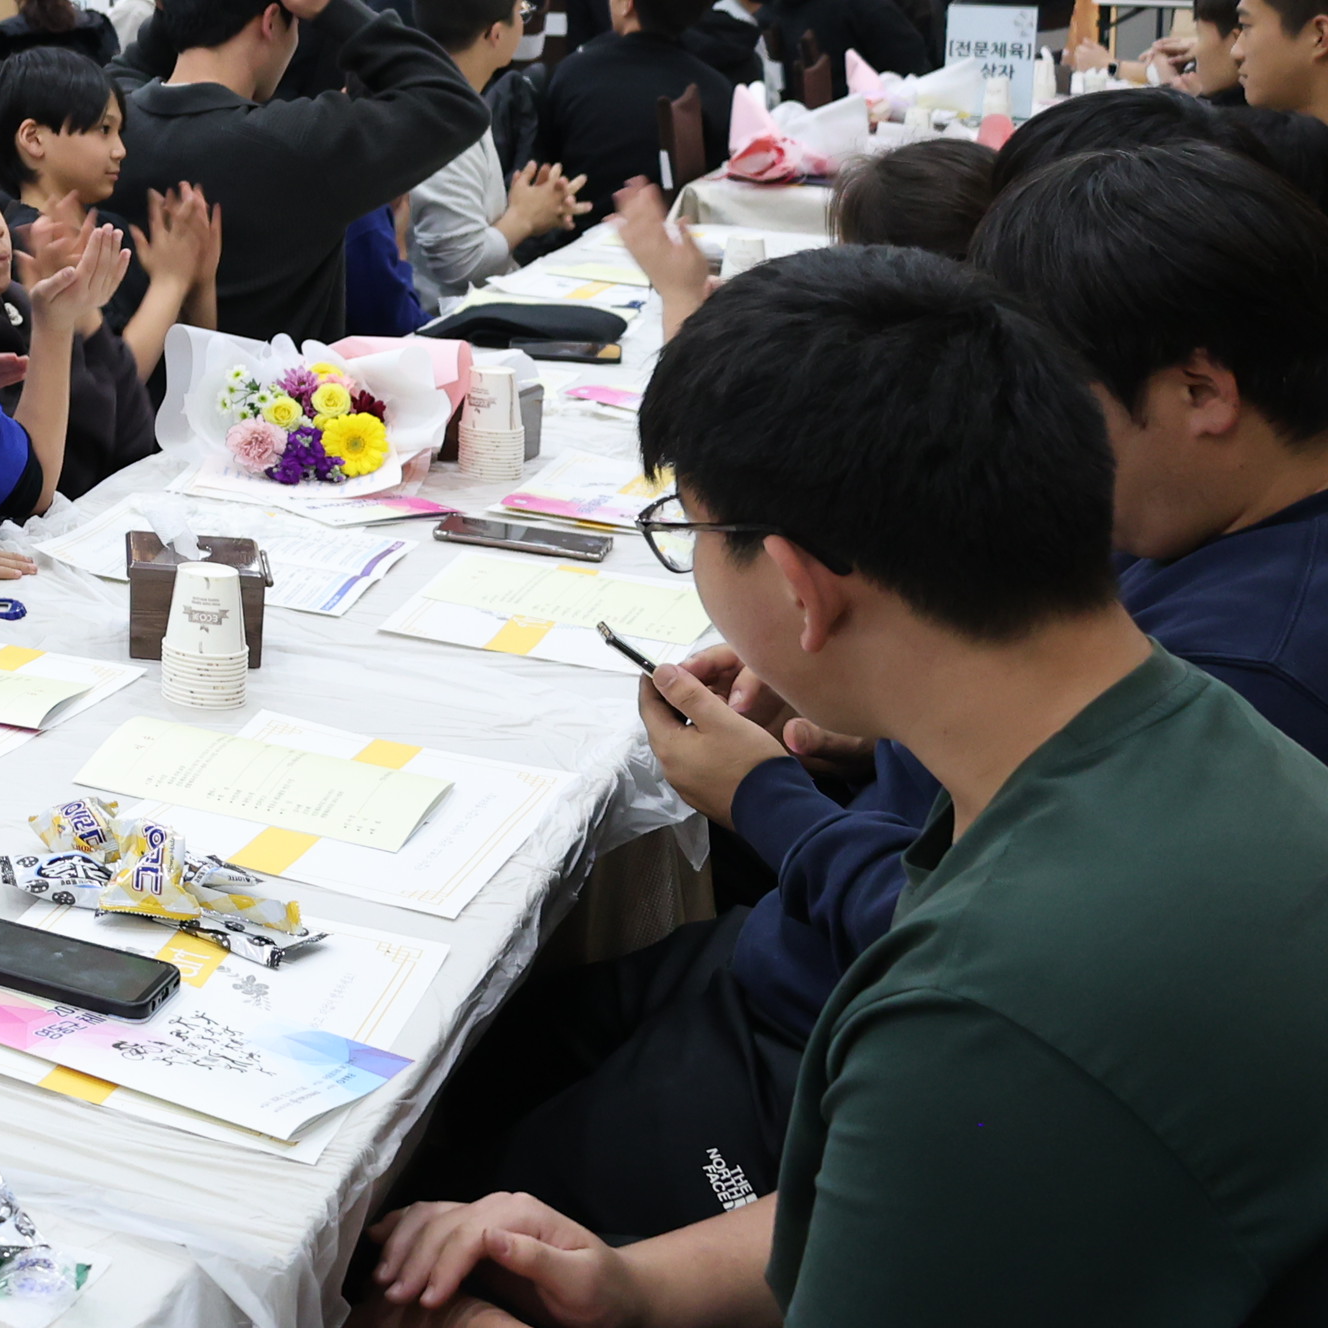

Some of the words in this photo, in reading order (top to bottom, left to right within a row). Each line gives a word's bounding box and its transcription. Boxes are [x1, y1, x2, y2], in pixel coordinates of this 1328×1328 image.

[948, 40, 1032, 60] [전문체육]
[702, 1164, 732, 1203] FACE
[705, 1147, 743, 1200] NORTH
[730, 1164, 754, 1196] THE
